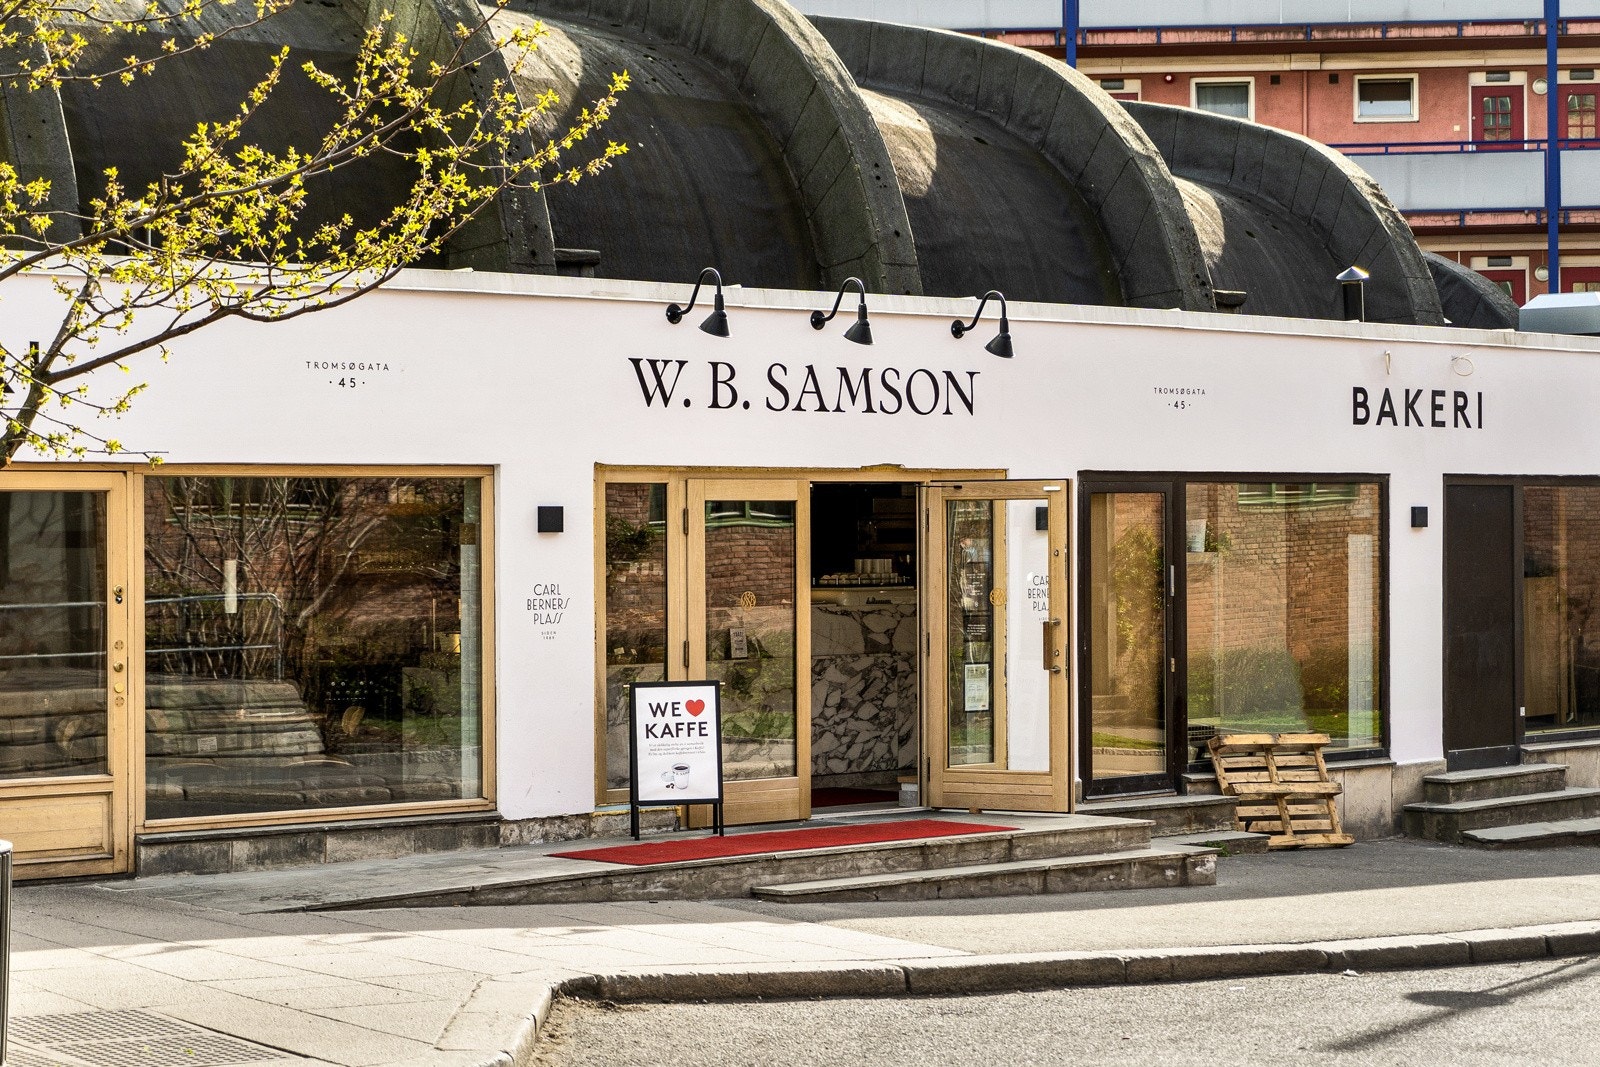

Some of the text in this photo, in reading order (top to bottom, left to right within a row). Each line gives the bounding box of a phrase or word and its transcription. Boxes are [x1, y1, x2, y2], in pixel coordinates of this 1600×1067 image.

[306, 361, 389, 371] TROMSØGATA
[628, 358, 981, 416] W. B. SAMSON
[1154, 387, 1206, 396] TROMSØGATA
[1352, 386, 1484, 429] BAKERI
[1032, 575, 1050, 586] CAR
[533, 583, 561, 596] CARL
[526, 597, 571, 611] BERNERS
[1032, 600, 1050, 612] PLA
[533, 612, 563, 625] PLASS
[648, 701, 682, 718] WE
[645, 721, 709, 739] KAFFE
